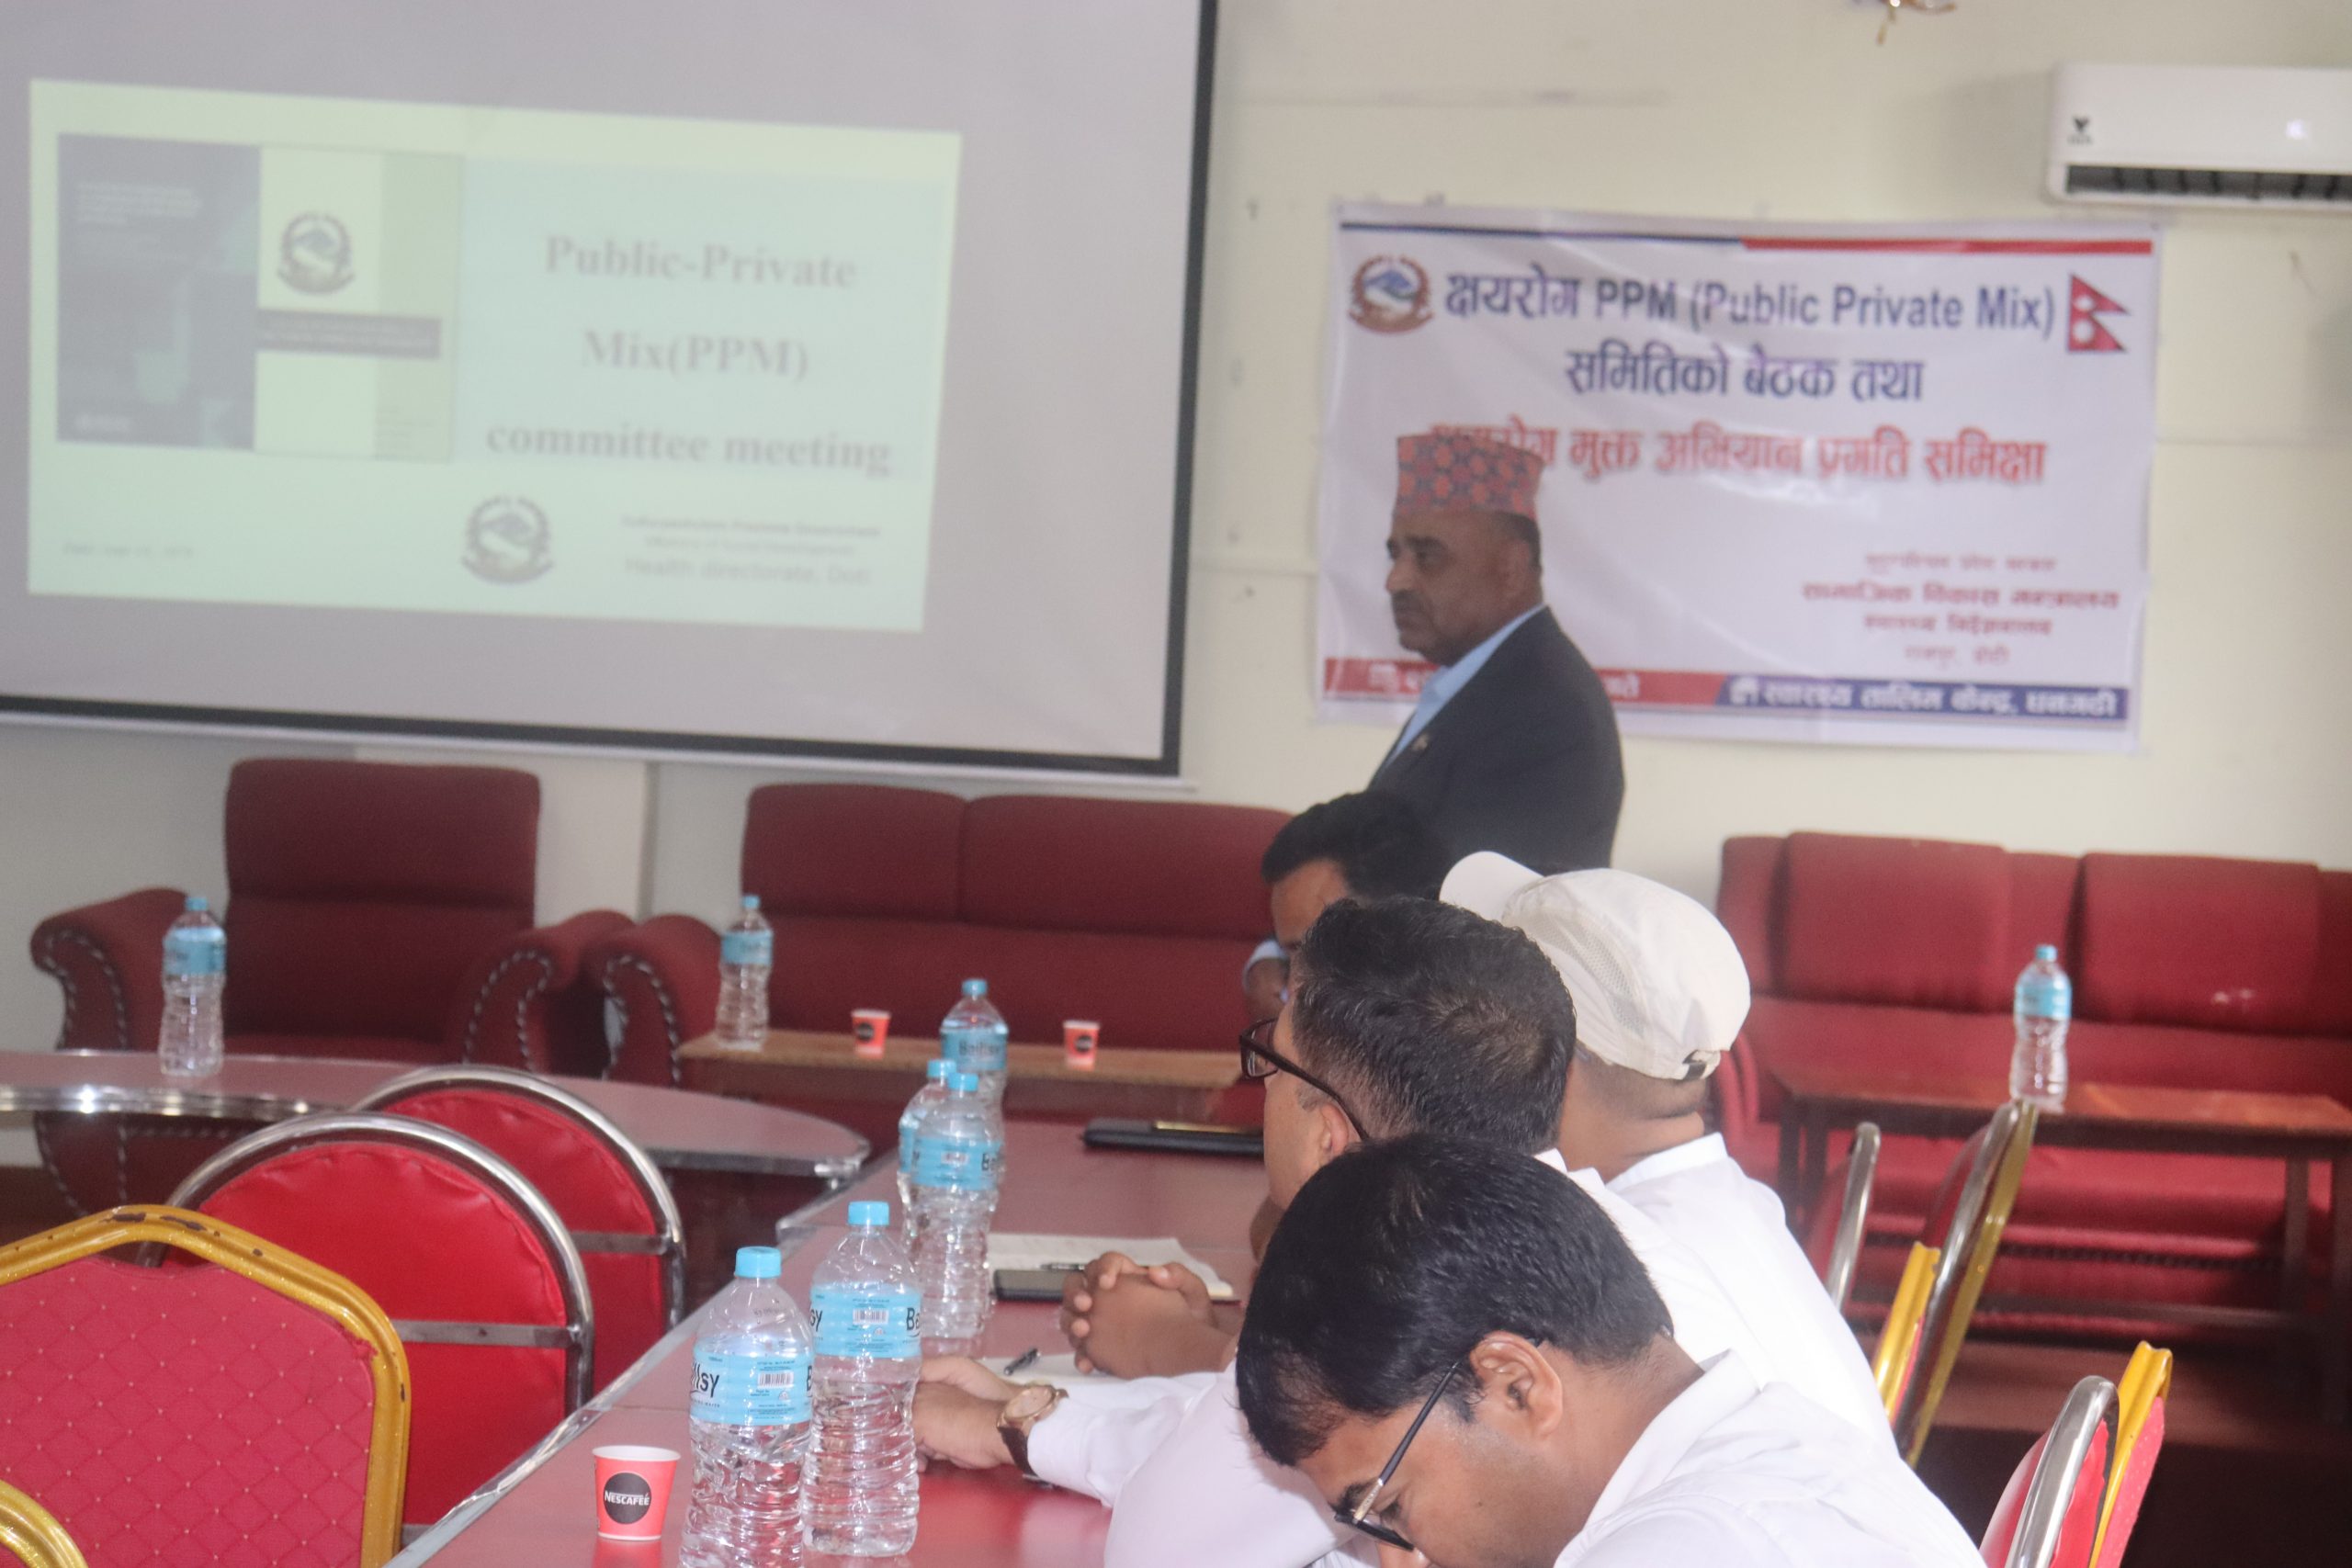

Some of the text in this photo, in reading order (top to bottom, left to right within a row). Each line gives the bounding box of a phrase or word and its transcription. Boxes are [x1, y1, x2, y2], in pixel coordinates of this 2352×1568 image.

[546, 234, 858, 290] Public-Private
[1445, 261, 2055, 341] क्षयरोग PPM (Public Private Mix)
[582, 328, 809, 383] Mix(PPM)
[1566, 337, 1926, 402] समितिको बैठक तथा
[485, 421, 708, 464] committee
[723, 429, 894, 479] meeting
[1925, 426, 2046, 484] समिक्षा
